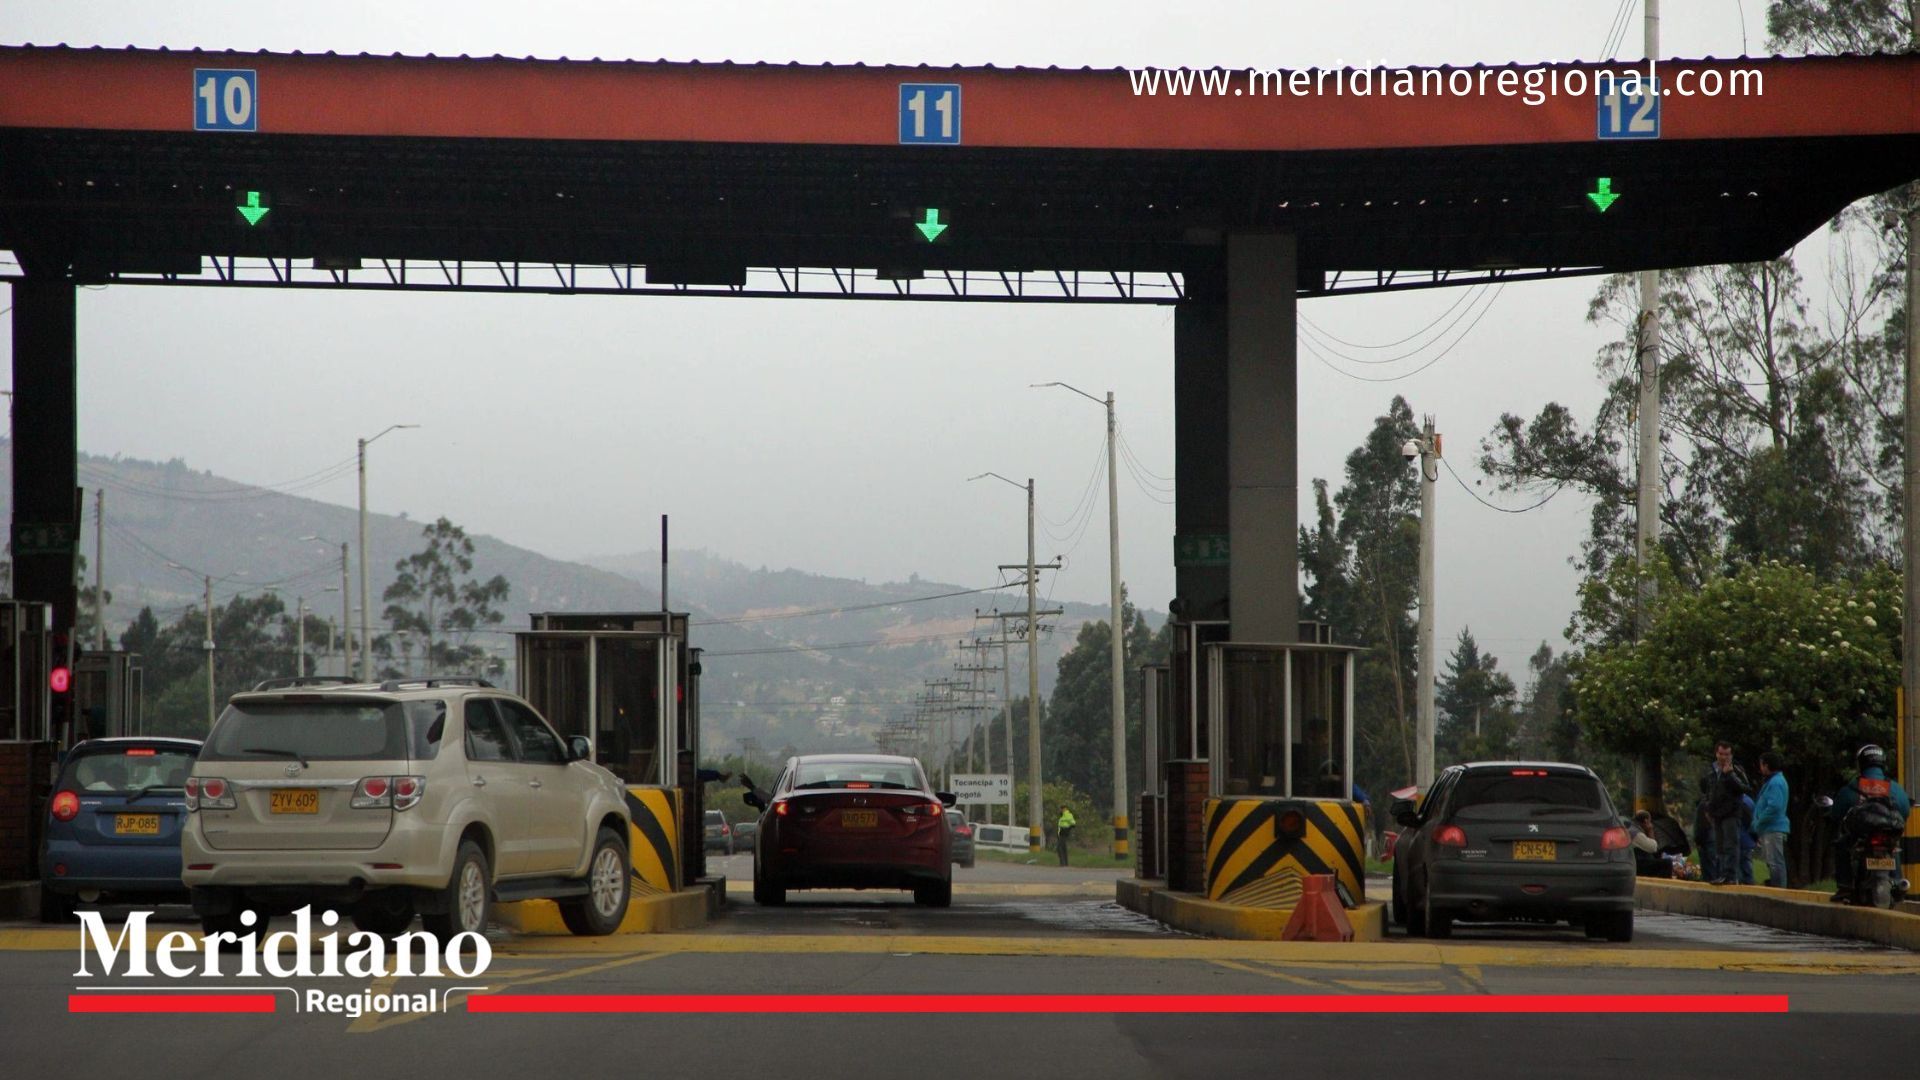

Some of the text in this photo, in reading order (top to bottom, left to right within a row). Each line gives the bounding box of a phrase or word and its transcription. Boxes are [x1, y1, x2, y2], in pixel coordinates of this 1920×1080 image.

[199, 76, 252, 126] 10
[908, 90, 952, 138] 11
[1604, 83, 1655, 133] 12
